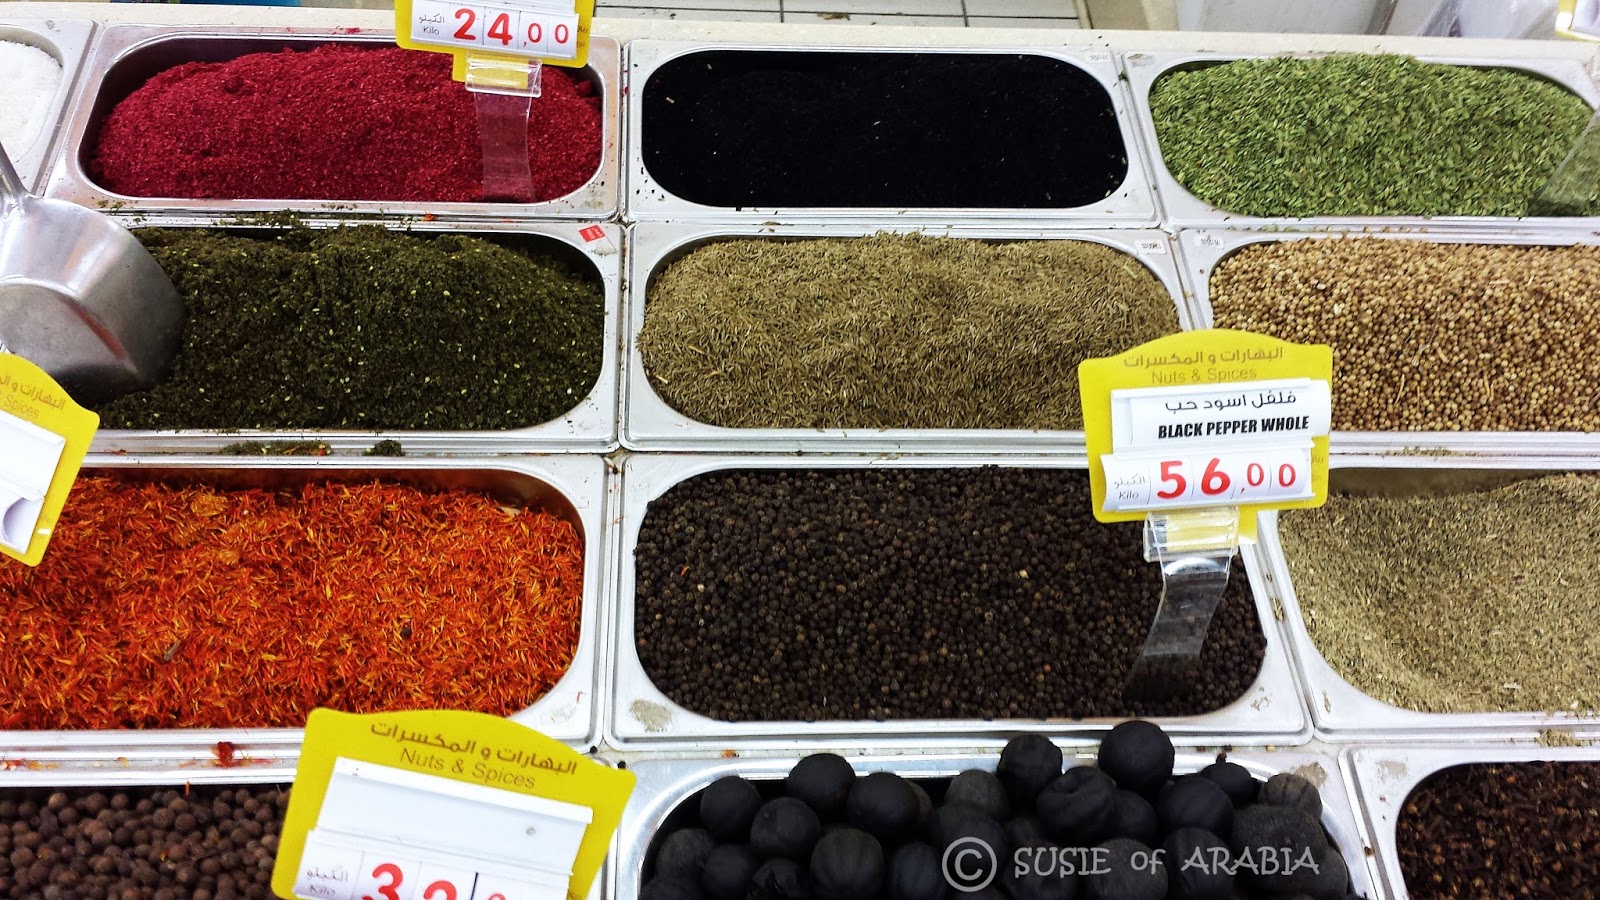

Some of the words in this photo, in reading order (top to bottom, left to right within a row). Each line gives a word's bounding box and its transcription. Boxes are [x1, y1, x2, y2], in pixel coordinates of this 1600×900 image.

[418, 13, 445, 24] الكيلو
[423, 26, 440, 35] Kilo
[1124, 352, 1203, 369] المكسرات
[1220, 347, 1284, 363] البهارات
[1152, 370, 1186, 384] Nuts
[1191, 369, 1202, 382] &
[1208, 367, 1257, 382] Spices
[1165, 398, 1198, 415] حب
[1204, 394, 1247, 411] اسود
[1252, 389, 1296, 409] فلفل
[1158, 422, 1203, 439] BLACK
[1206, 419, 1258, 437] PEPPER
[1261, 415, 1309, 432] WHOLE
[1119, 491, 1139, 499] Kilo
[371, 721, 476, 754] المكسرات
[400, 747, 446, 772] Nuts
[451, 760, 465, 774] &
[472, 765, 536, 789] Spices
[497, 749, 577, 775] البهارات
